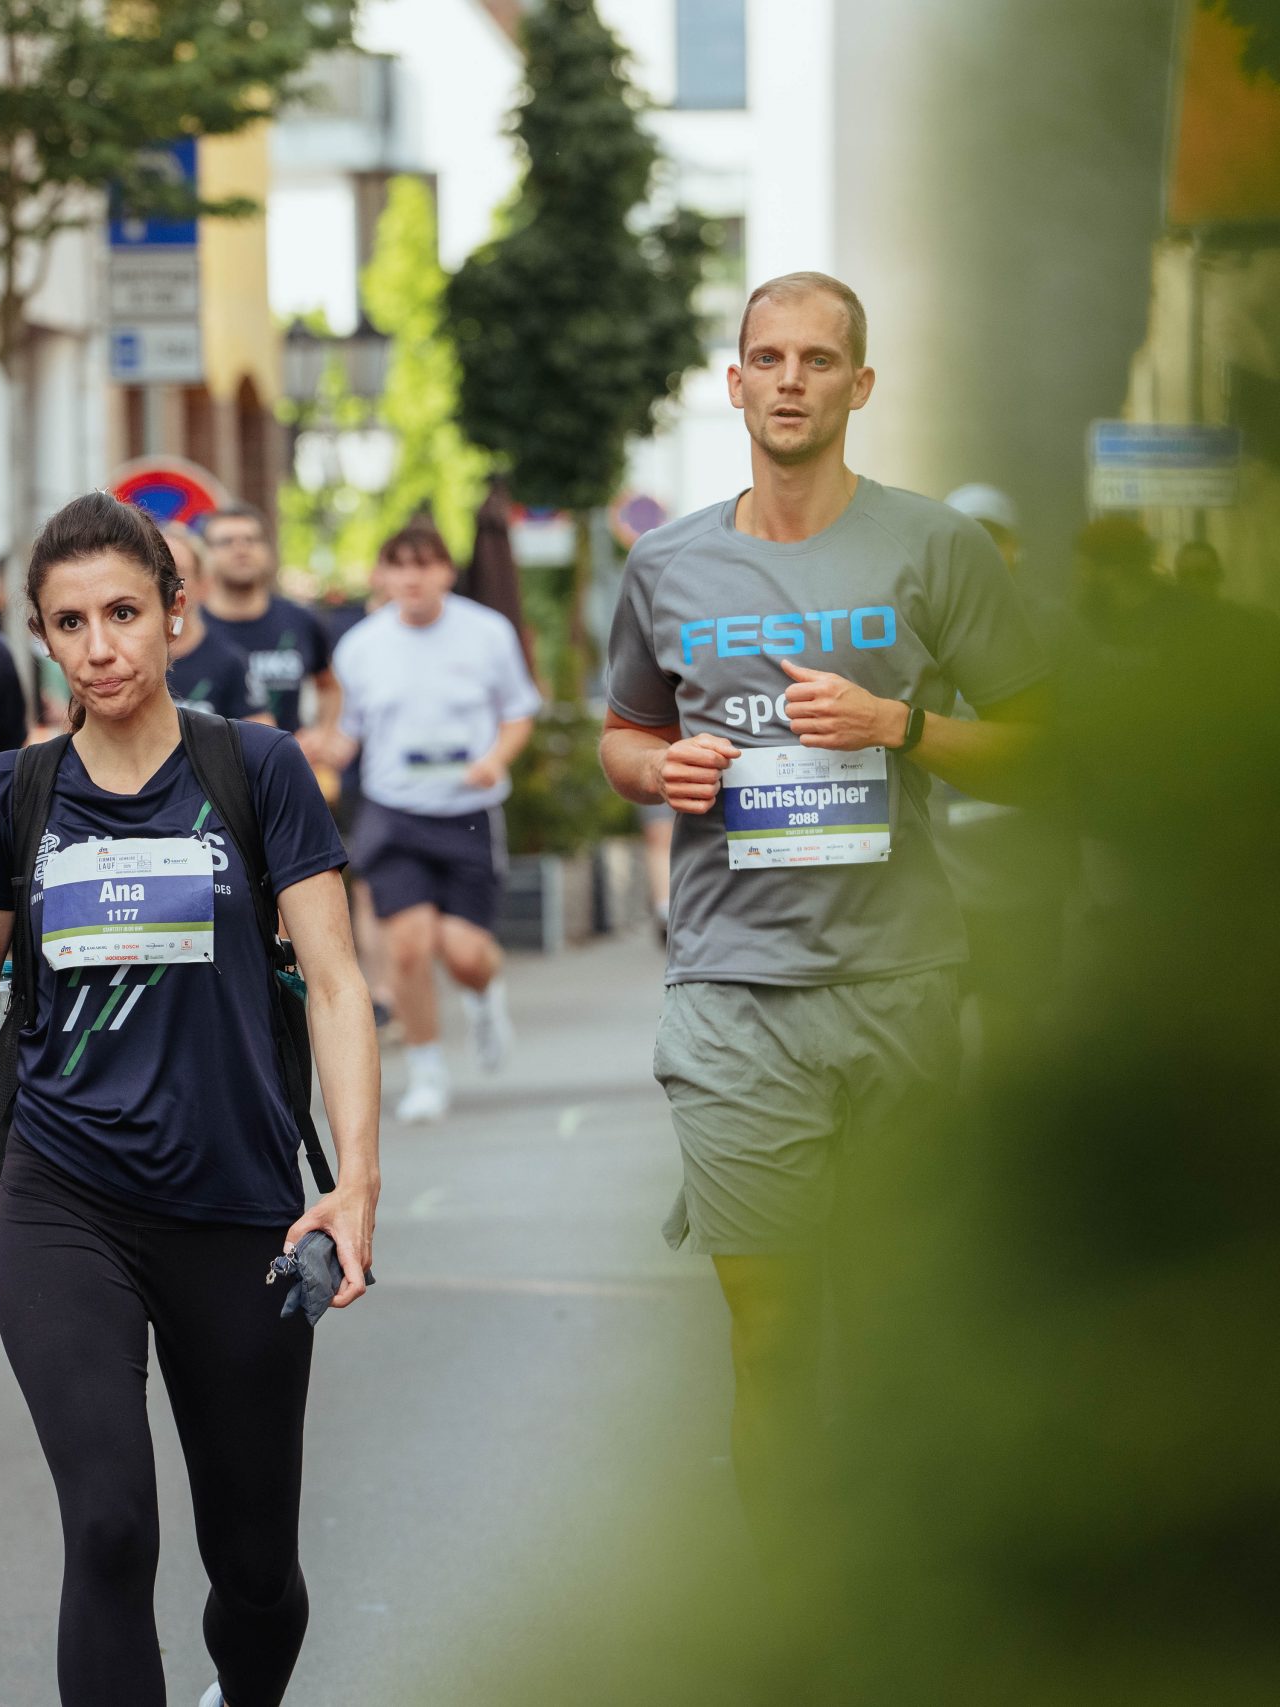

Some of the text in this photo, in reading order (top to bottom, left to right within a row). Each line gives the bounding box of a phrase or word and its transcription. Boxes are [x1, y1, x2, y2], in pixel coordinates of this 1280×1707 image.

[680, 605, 897, 666] FESTO
[778, 768, 794, 776] LAUF
[739, 783, 869, 810] Christopher
[788, 812, 819, 825] 2088
[98, 862, 115, 870] LAUF
[99, 880, 145, 903] Ana
[106, 908, 138, 921] 1177
